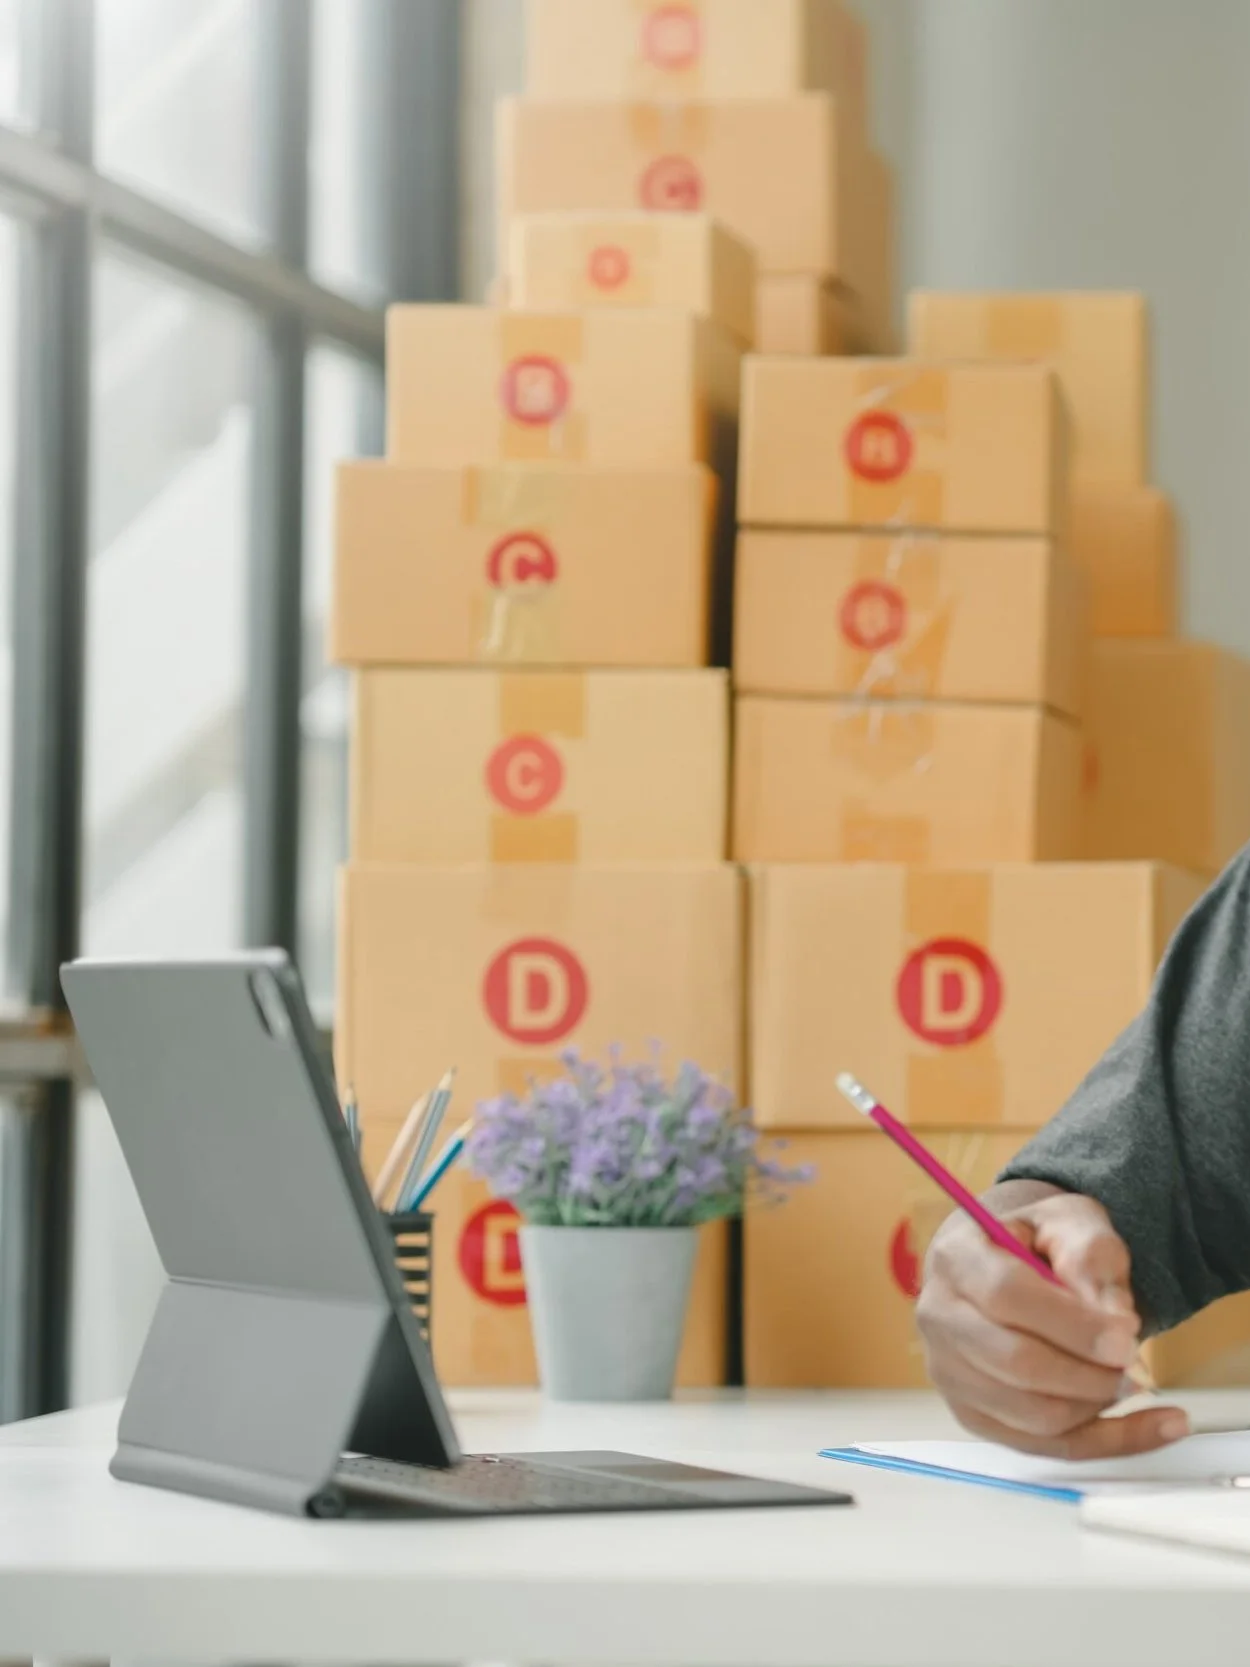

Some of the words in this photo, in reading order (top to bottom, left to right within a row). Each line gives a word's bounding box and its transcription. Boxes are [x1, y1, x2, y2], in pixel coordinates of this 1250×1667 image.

[506, 750, 543, 801] C
[509, 954, 567, 1027] D
[922, 957, 982, 1028] D
